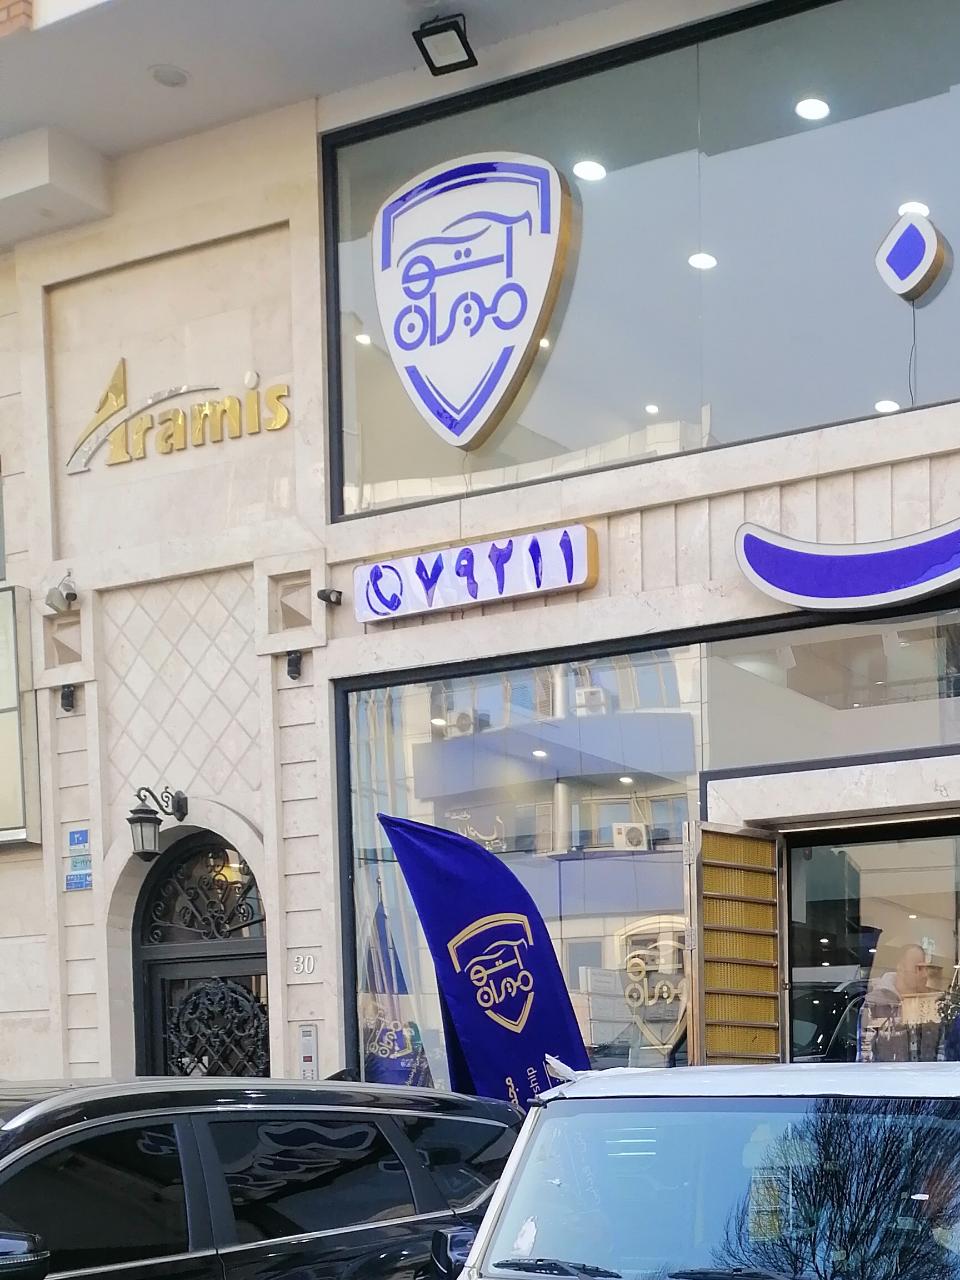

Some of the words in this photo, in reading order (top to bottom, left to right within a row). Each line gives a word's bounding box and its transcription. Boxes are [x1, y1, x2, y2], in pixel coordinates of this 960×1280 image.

[402, 225, 513, 300] اتو
[394, 282, 528, 351] مدیران
[66, 357, 290, 475] Aramis
[293, 955, 315, 974] 30
[477, 969, 534, 1008] مدیران
